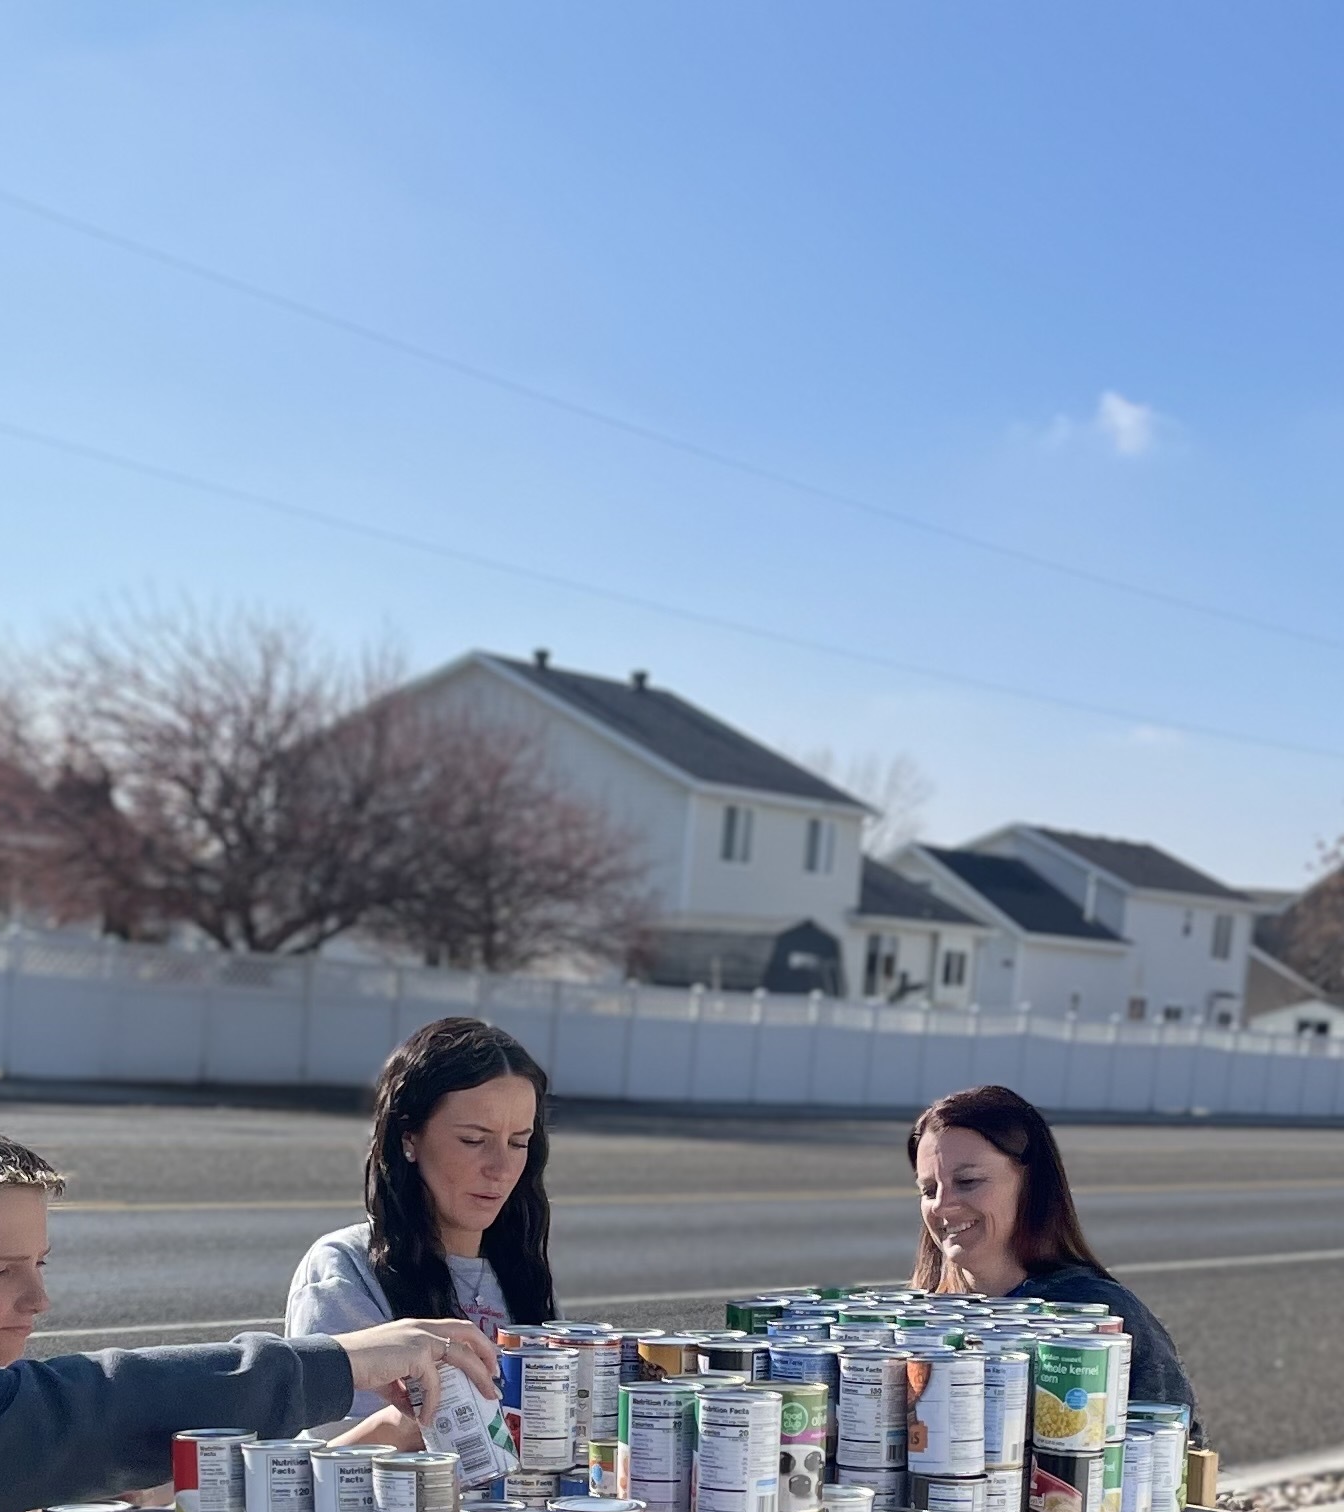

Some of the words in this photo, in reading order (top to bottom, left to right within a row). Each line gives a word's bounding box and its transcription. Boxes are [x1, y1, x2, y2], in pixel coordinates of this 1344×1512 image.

[1042, 1362, 1067, 1375] whole
[1069, 1364, 1099, 1376] kernel
[1040, 1373, 1058, 1384] corn
[729, 1407, 750, 1415] Facts
[783, 1411, 803, 1420] food
[783, 1419, 802, 1430] club
[271, 1459, 309, 1467] Nutrition
[339, 1476, 364, 1484] Facts
[294, 1487, 310, 1497] 120
